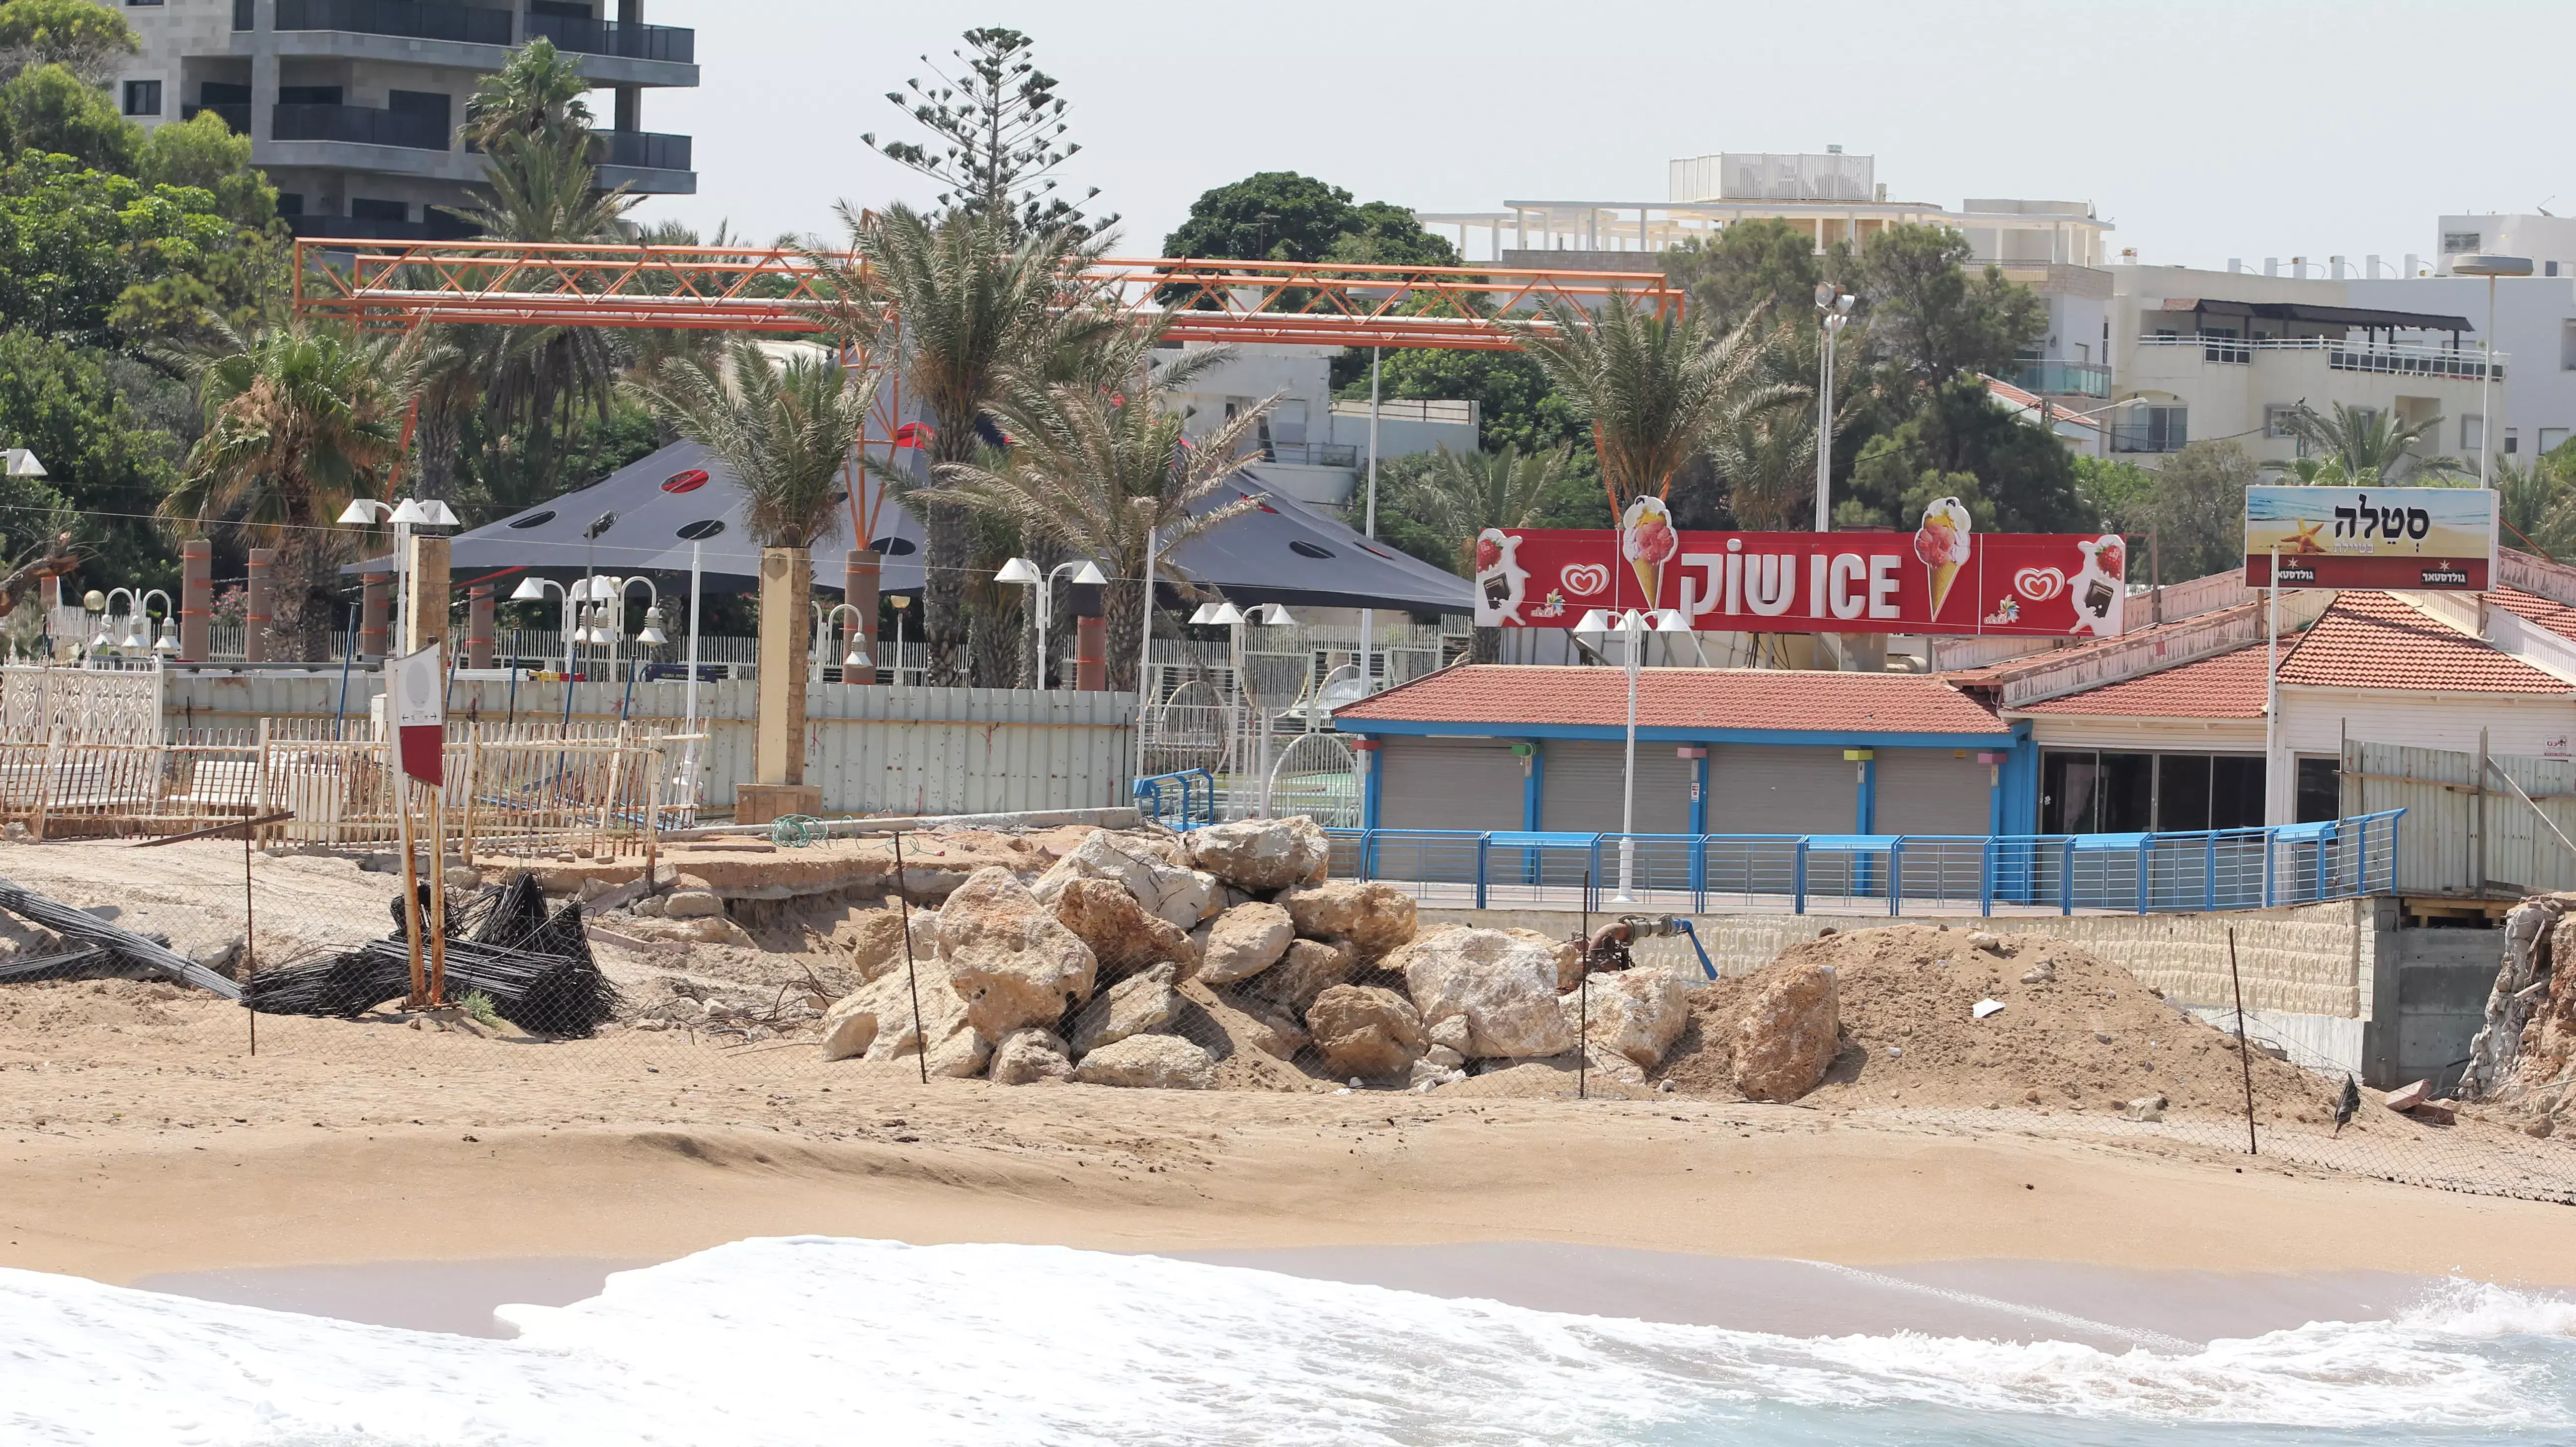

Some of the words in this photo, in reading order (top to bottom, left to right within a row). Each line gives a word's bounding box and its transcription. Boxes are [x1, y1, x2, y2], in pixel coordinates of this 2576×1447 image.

[2334, 543, 2374, 554] בטיילת
[2278, 570, 2314, 580] גולדסטא
[1810, 553, 1902, 620] ICE
